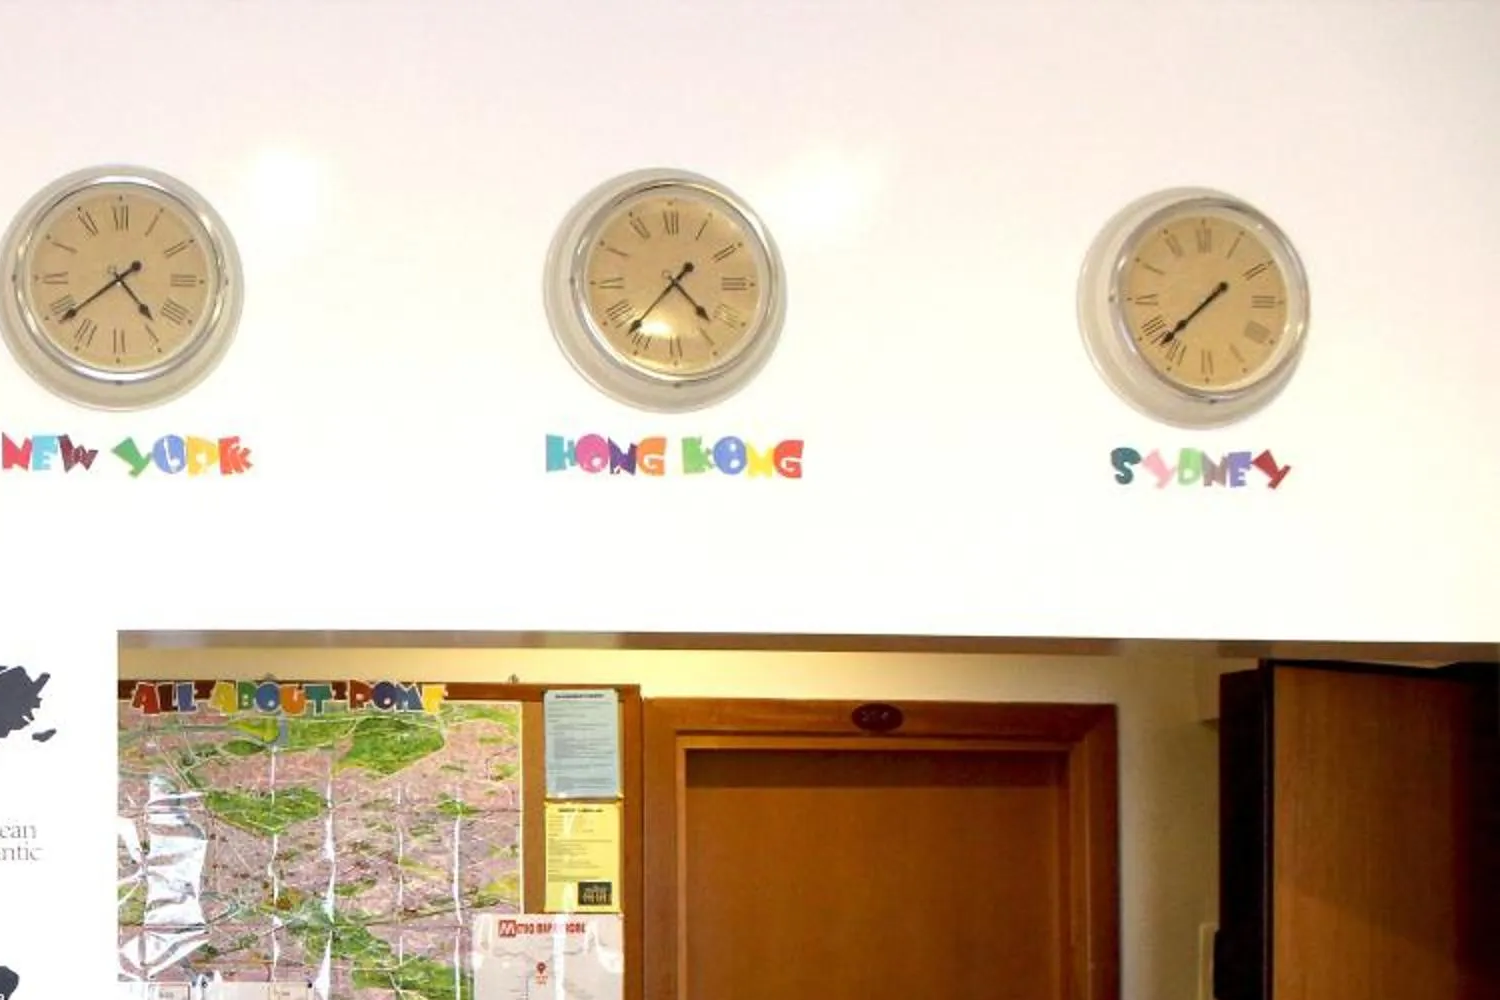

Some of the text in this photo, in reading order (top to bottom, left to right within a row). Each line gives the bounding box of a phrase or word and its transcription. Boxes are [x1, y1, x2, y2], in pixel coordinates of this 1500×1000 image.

[1, 431, 253, 478] NEW YORK
[546, 433, 804, 479] HONG KONG
[1110, 447, 1291, 490] SYDNEY
[131, 680, 448, 716] ALL ABOUT ROME
